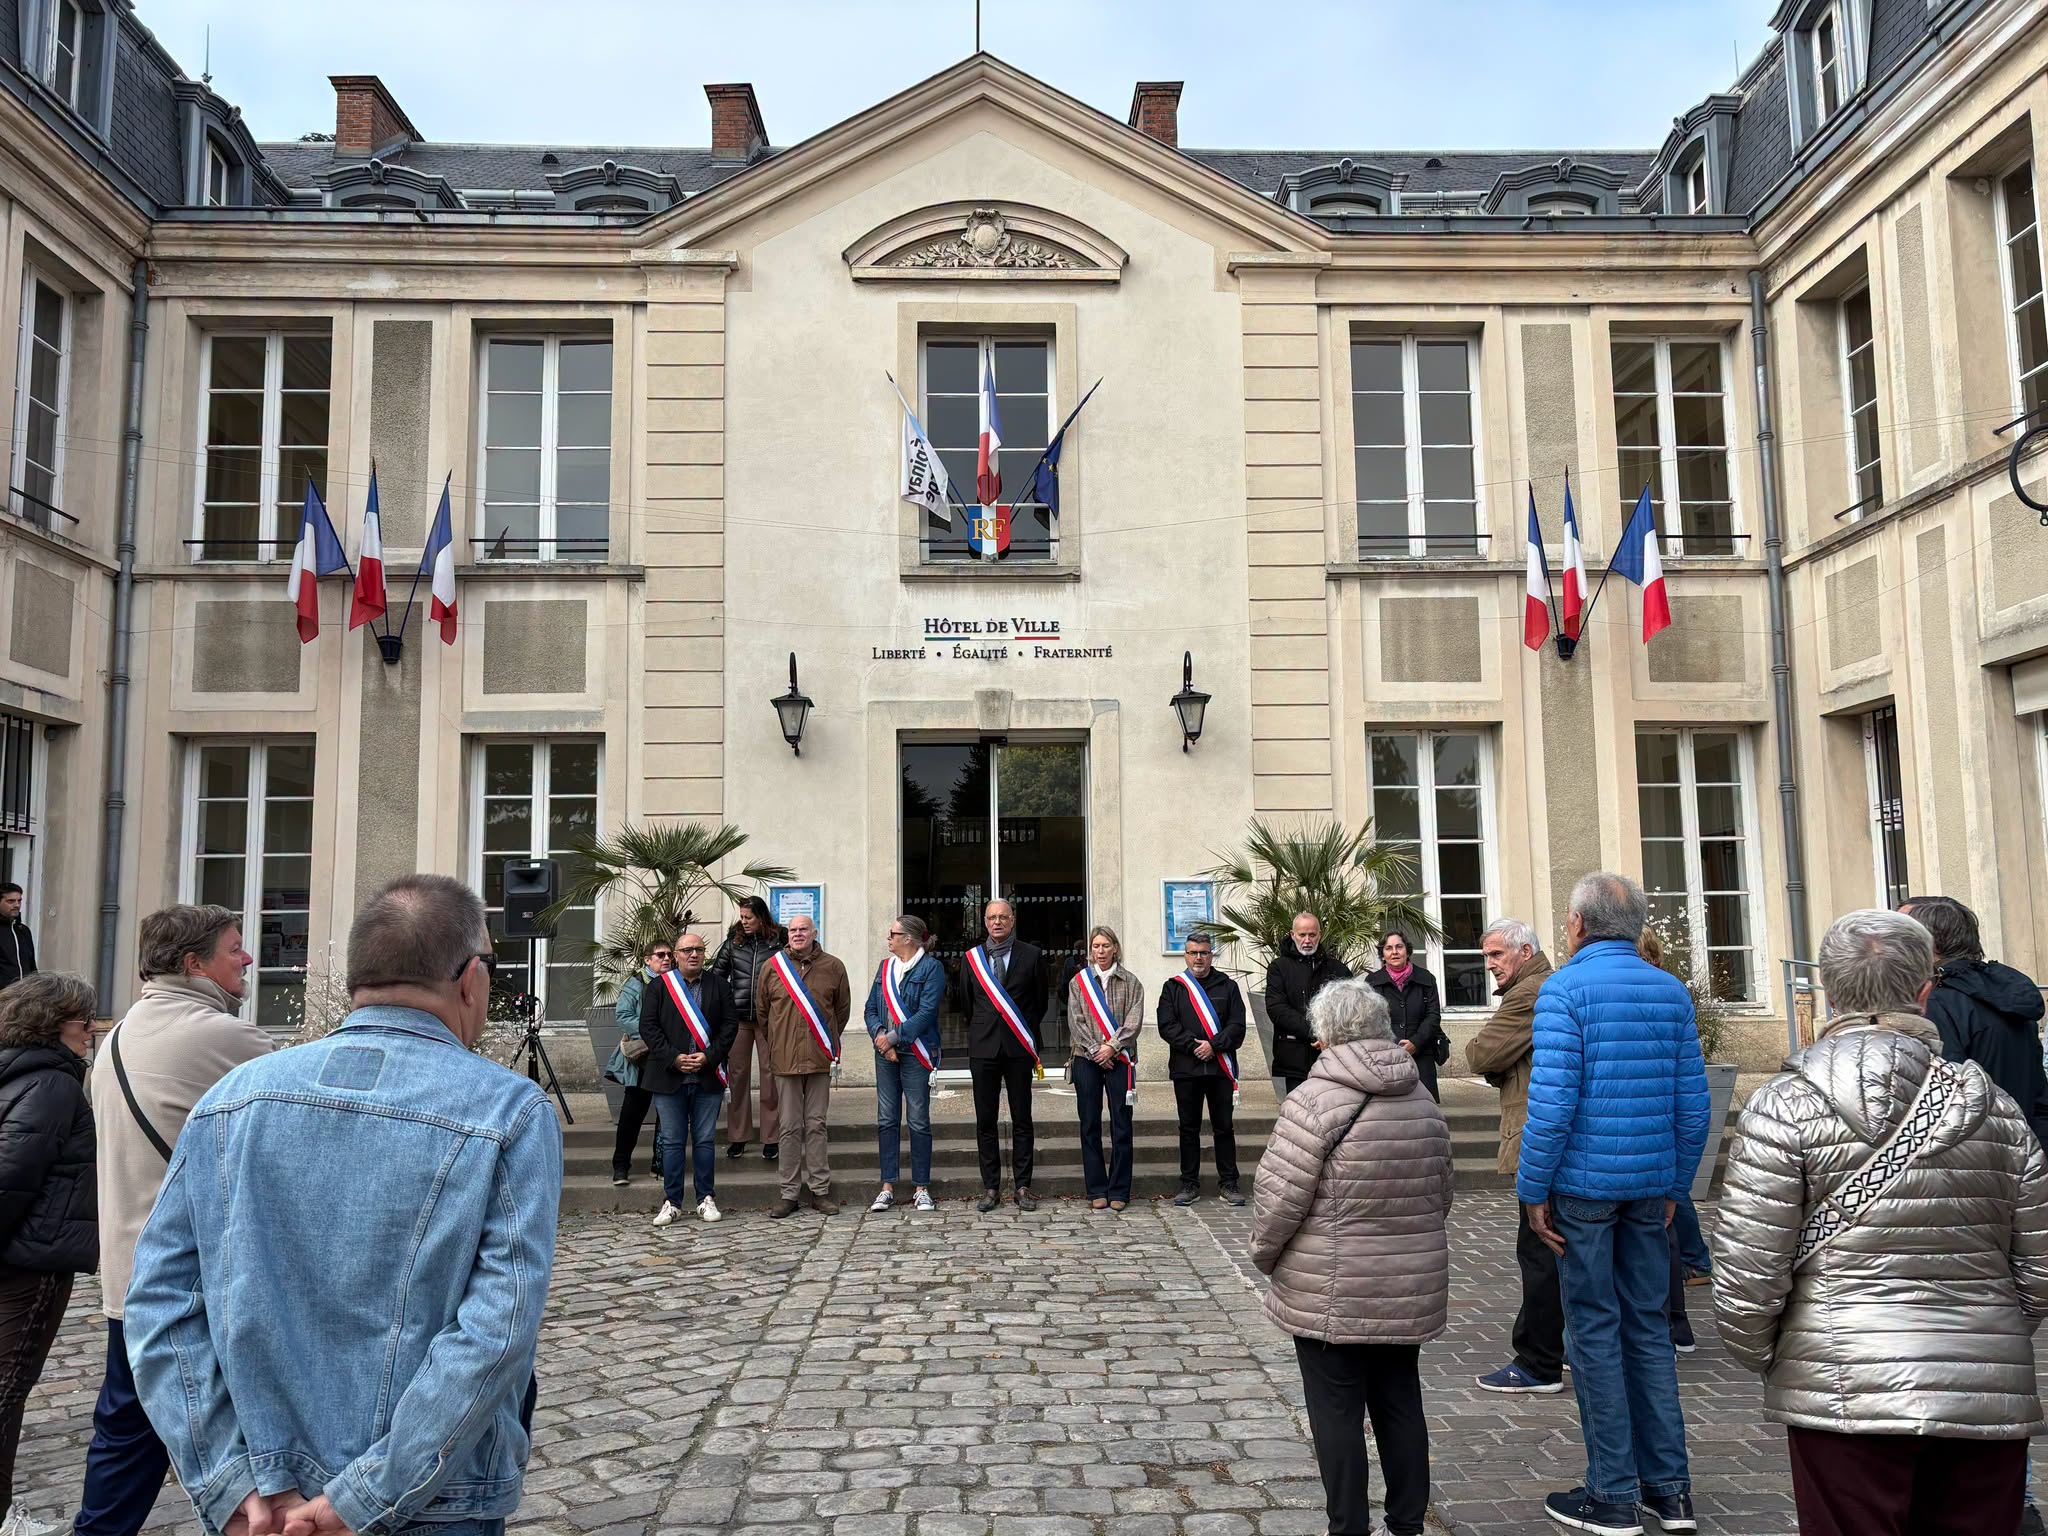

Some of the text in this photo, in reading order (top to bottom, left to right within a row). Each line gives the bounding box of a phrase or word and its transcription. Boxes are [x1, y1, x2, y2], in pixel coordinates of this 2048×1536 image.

[972, 518, 1006, 540] RF
[924, 617, 1060, 633] HÔTEL DE VILLE
[872, 643, 1113, 659] LIBERTÉ ÉGALITÉ FRATERNITÉ
